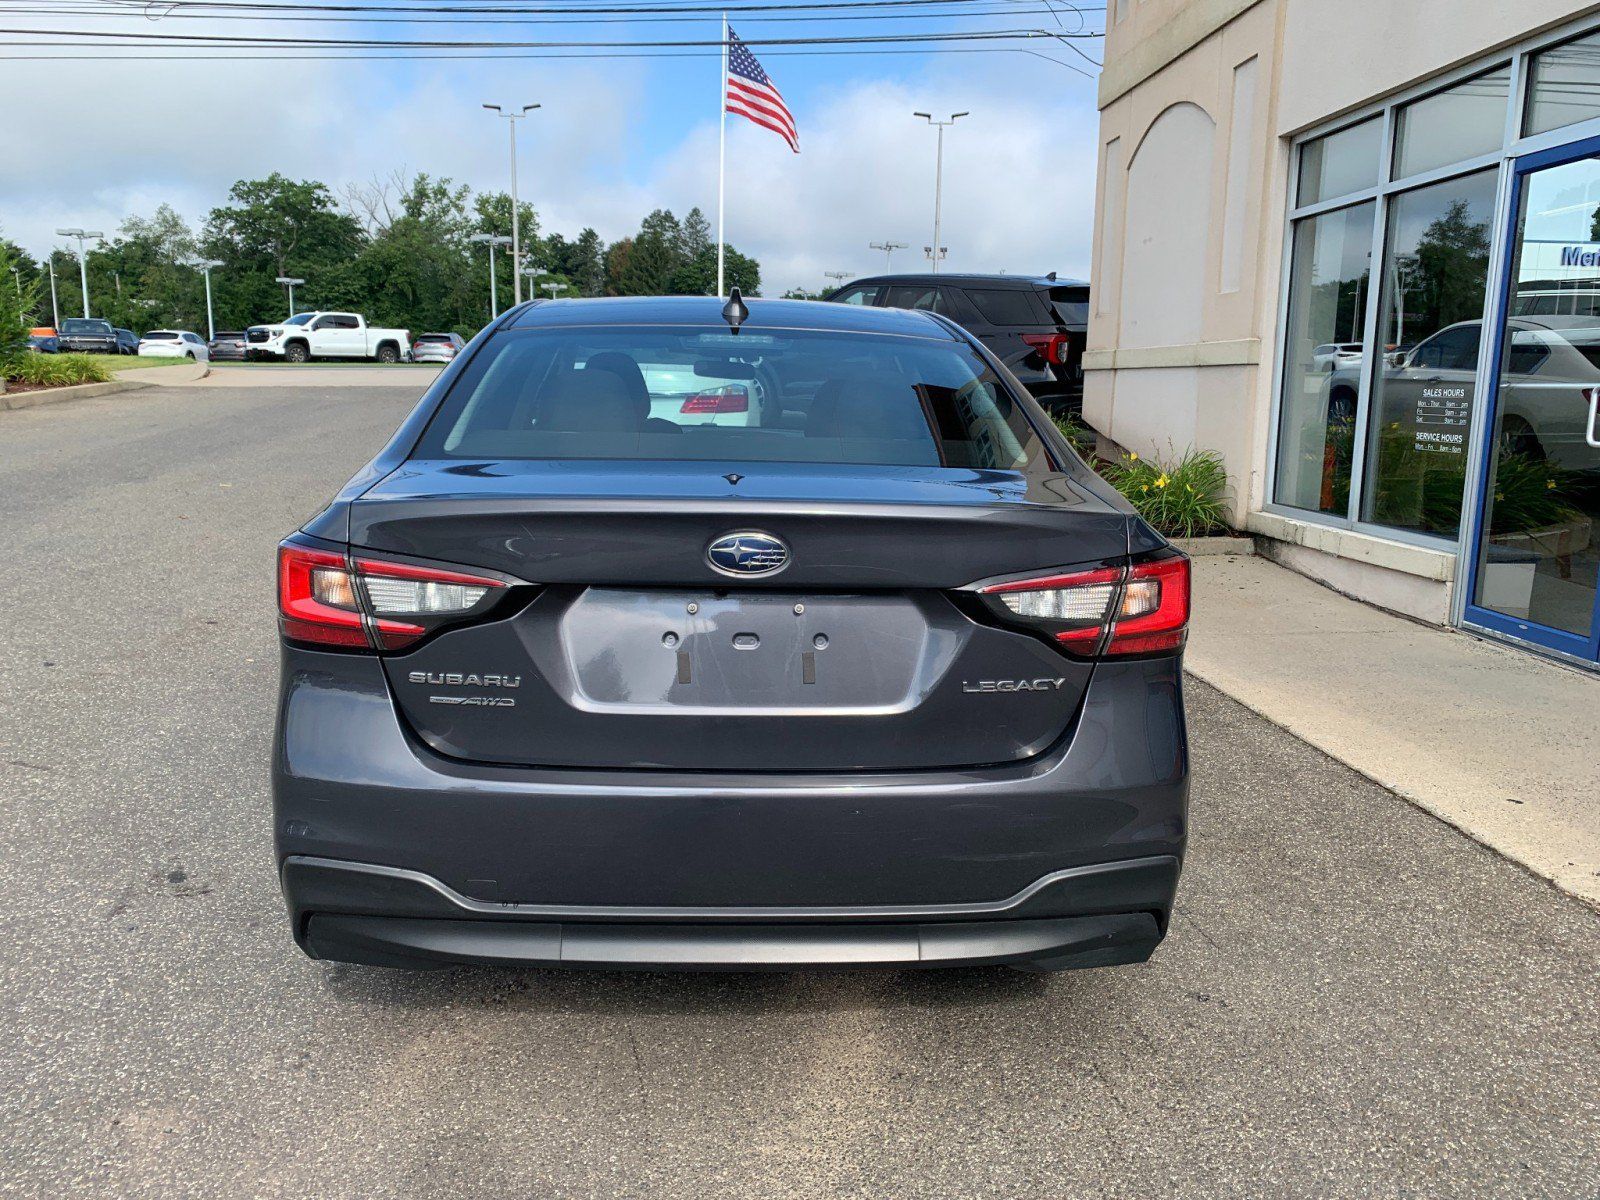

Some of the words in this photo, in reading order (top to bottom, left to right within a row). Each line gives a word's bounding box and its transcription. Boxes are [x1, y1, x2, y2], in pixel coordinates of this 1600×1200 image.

[1423, 388, 1442, 397] SALES
[1443, 388, 1465, 397] HOURS
[1415, 432, 1440, 441] SERVICE
[1441, 434, 1463, 443] HOURS
[408, 671, 521, 688] SUBARU
[961, 677, 1066, 693] LEGACY
[460, 697, 516, 707] AWD
